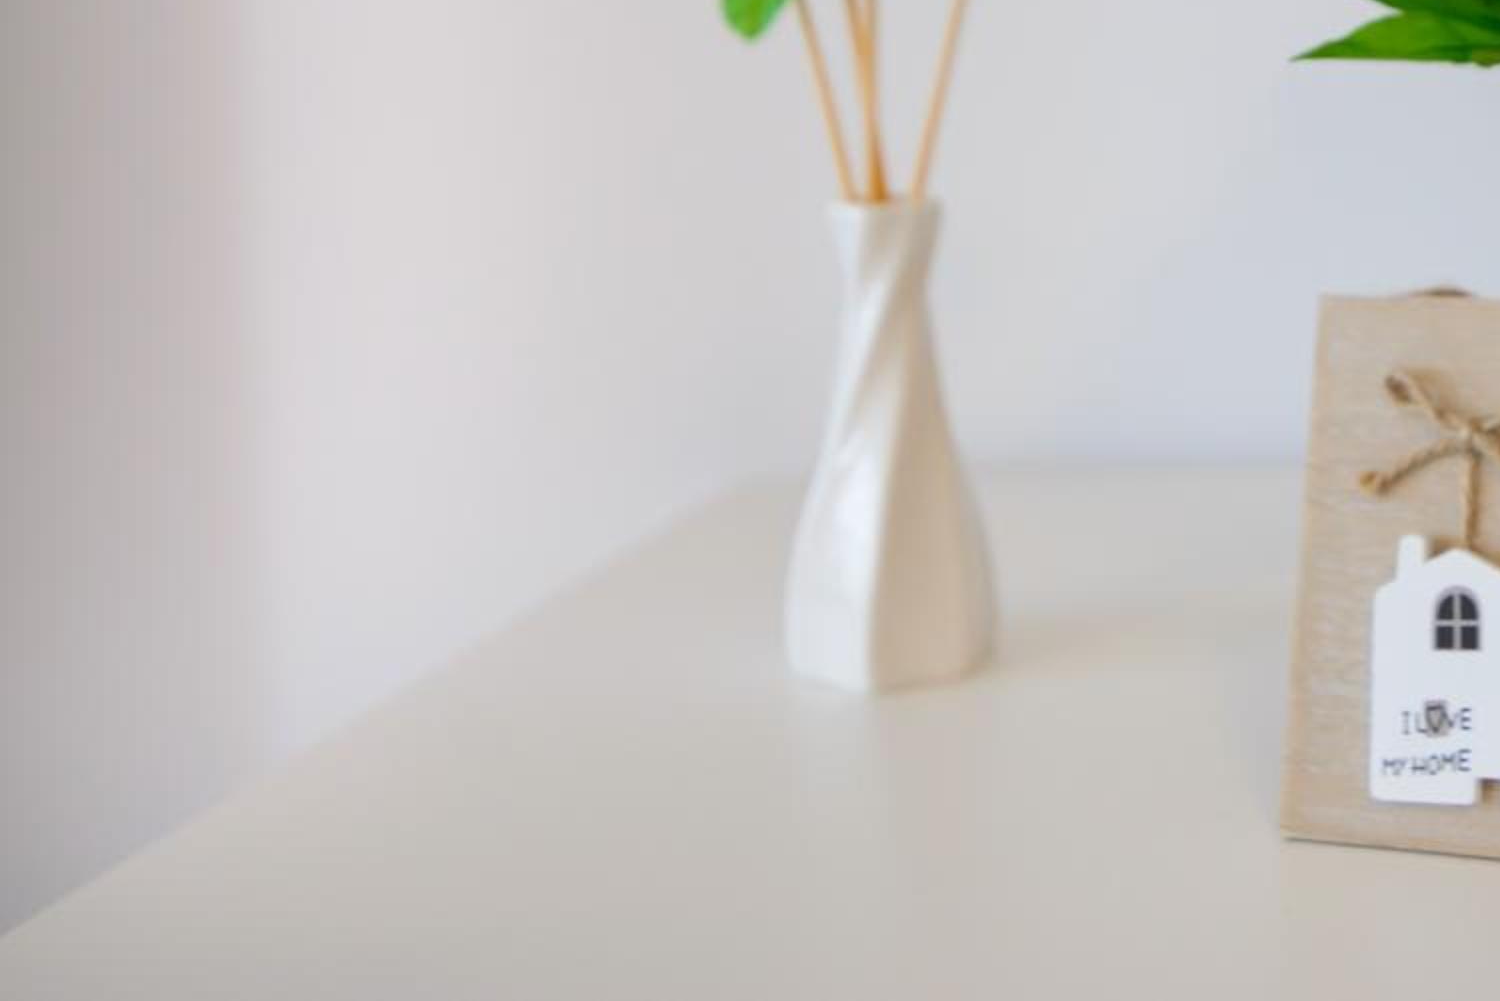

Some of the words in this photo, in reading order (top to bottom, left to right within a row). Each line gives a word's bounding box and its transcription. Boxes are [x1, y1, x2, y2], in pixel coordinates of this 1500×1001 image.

[1400, 709, 1411, 737] I
[1380, 756, 1407, 777] MY
[1410, 748, 1473, 777] HOME
